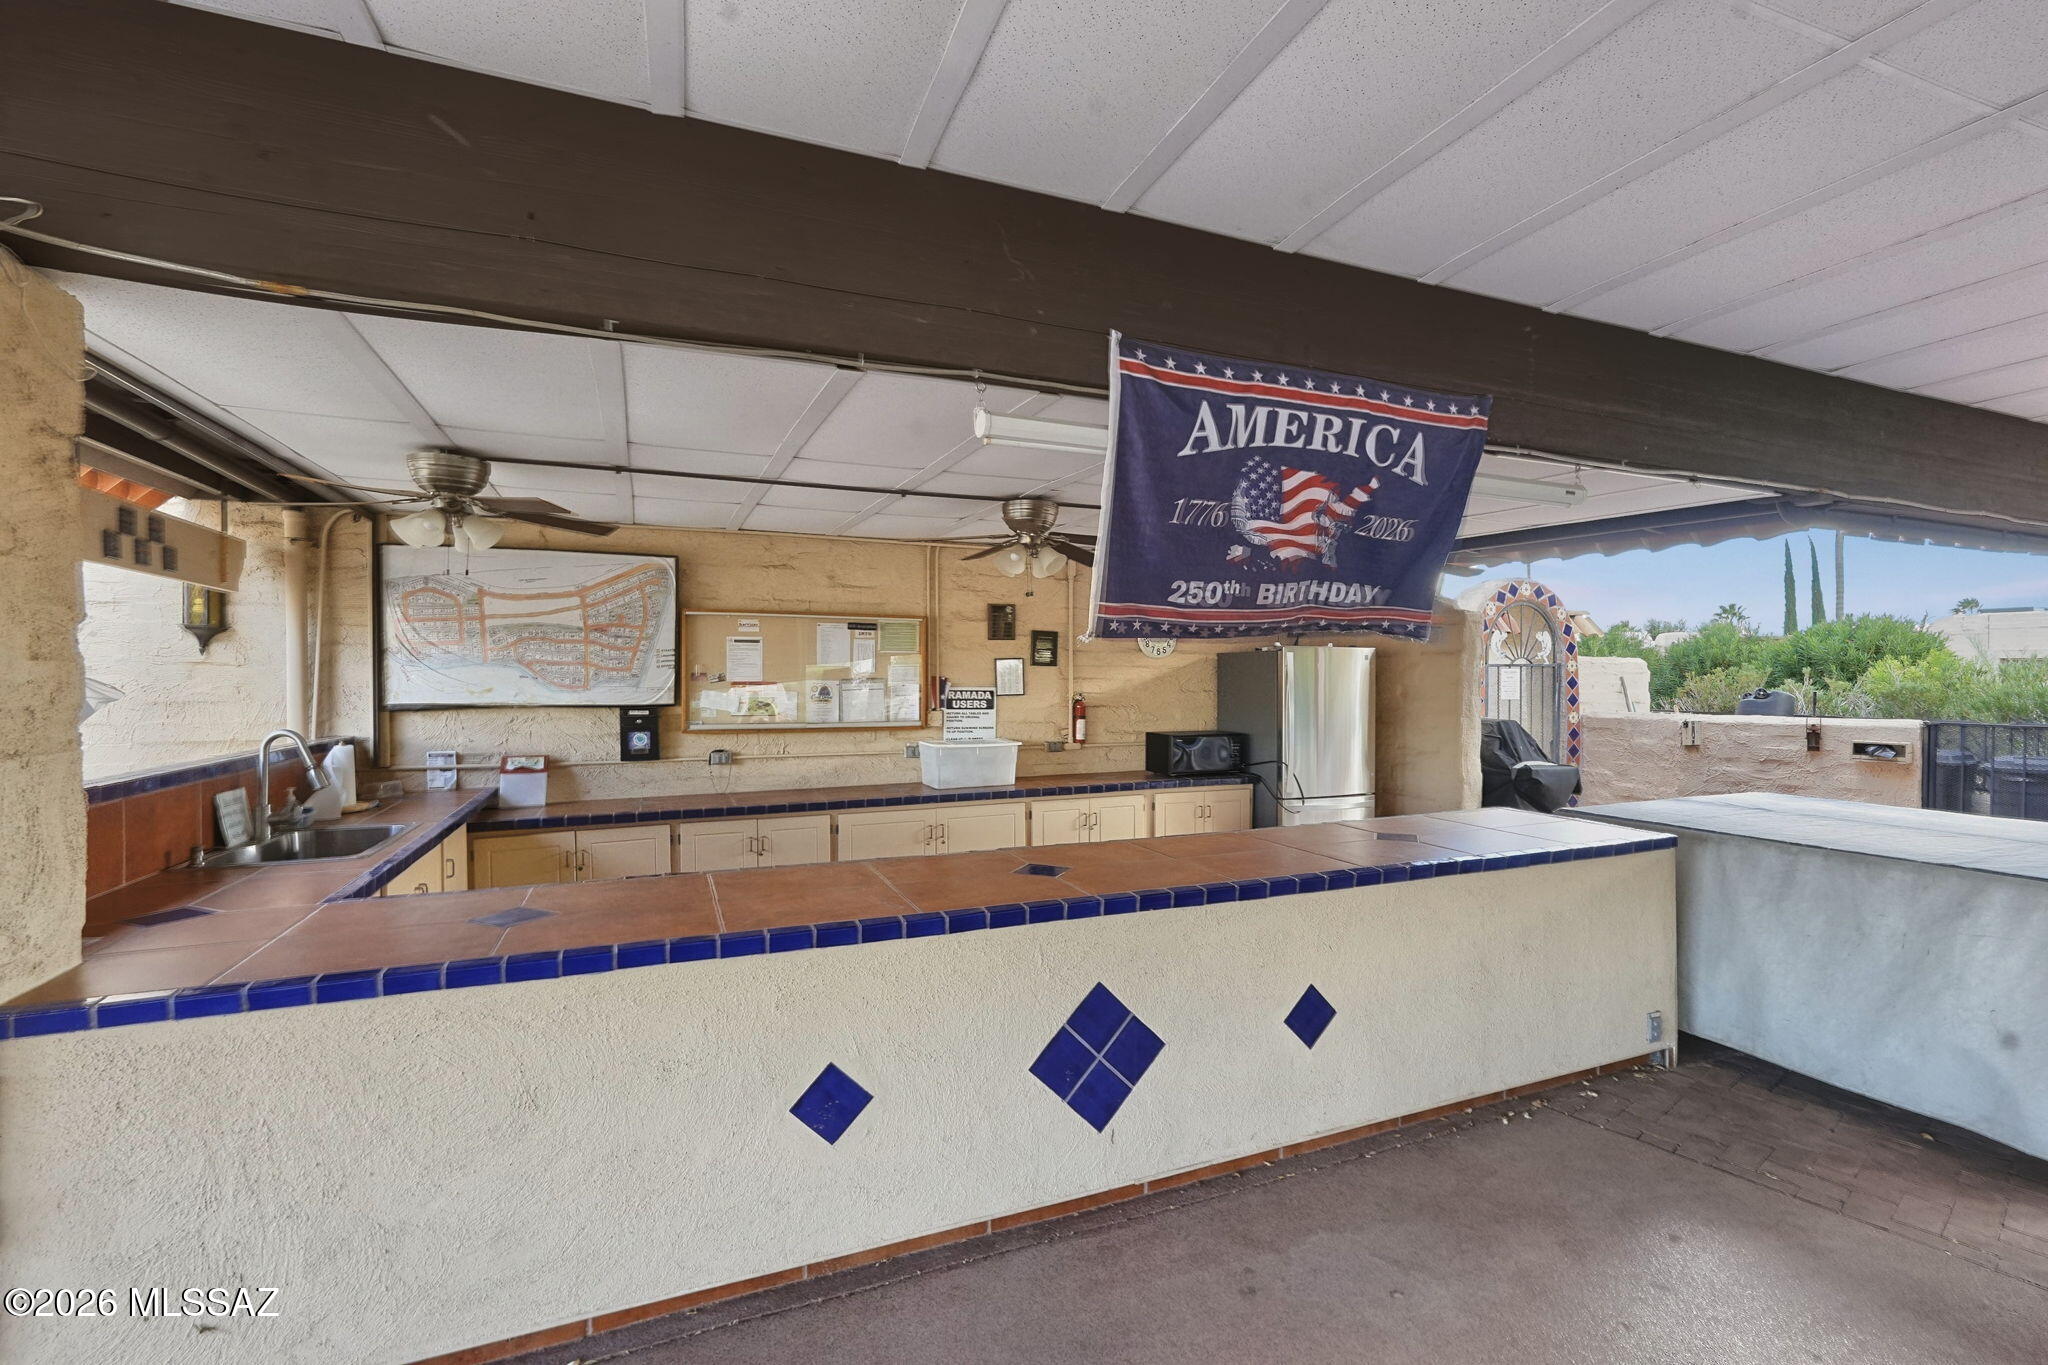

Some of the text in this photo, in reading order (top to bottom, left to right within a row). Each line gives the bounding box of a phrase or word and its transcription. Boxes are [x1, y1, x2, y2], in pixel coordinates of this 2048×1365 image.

[1177, 400, 1428, 486] AMERICA
[1168, 498, 1230, 528] 1776
[1354, 515, 1417, 542] 2026
[1167, 579, 1381, 605] 250th BIRTHDAY
[948, 691, 992, 700] RAMADA
[952, 700, 987, 708] USERS
